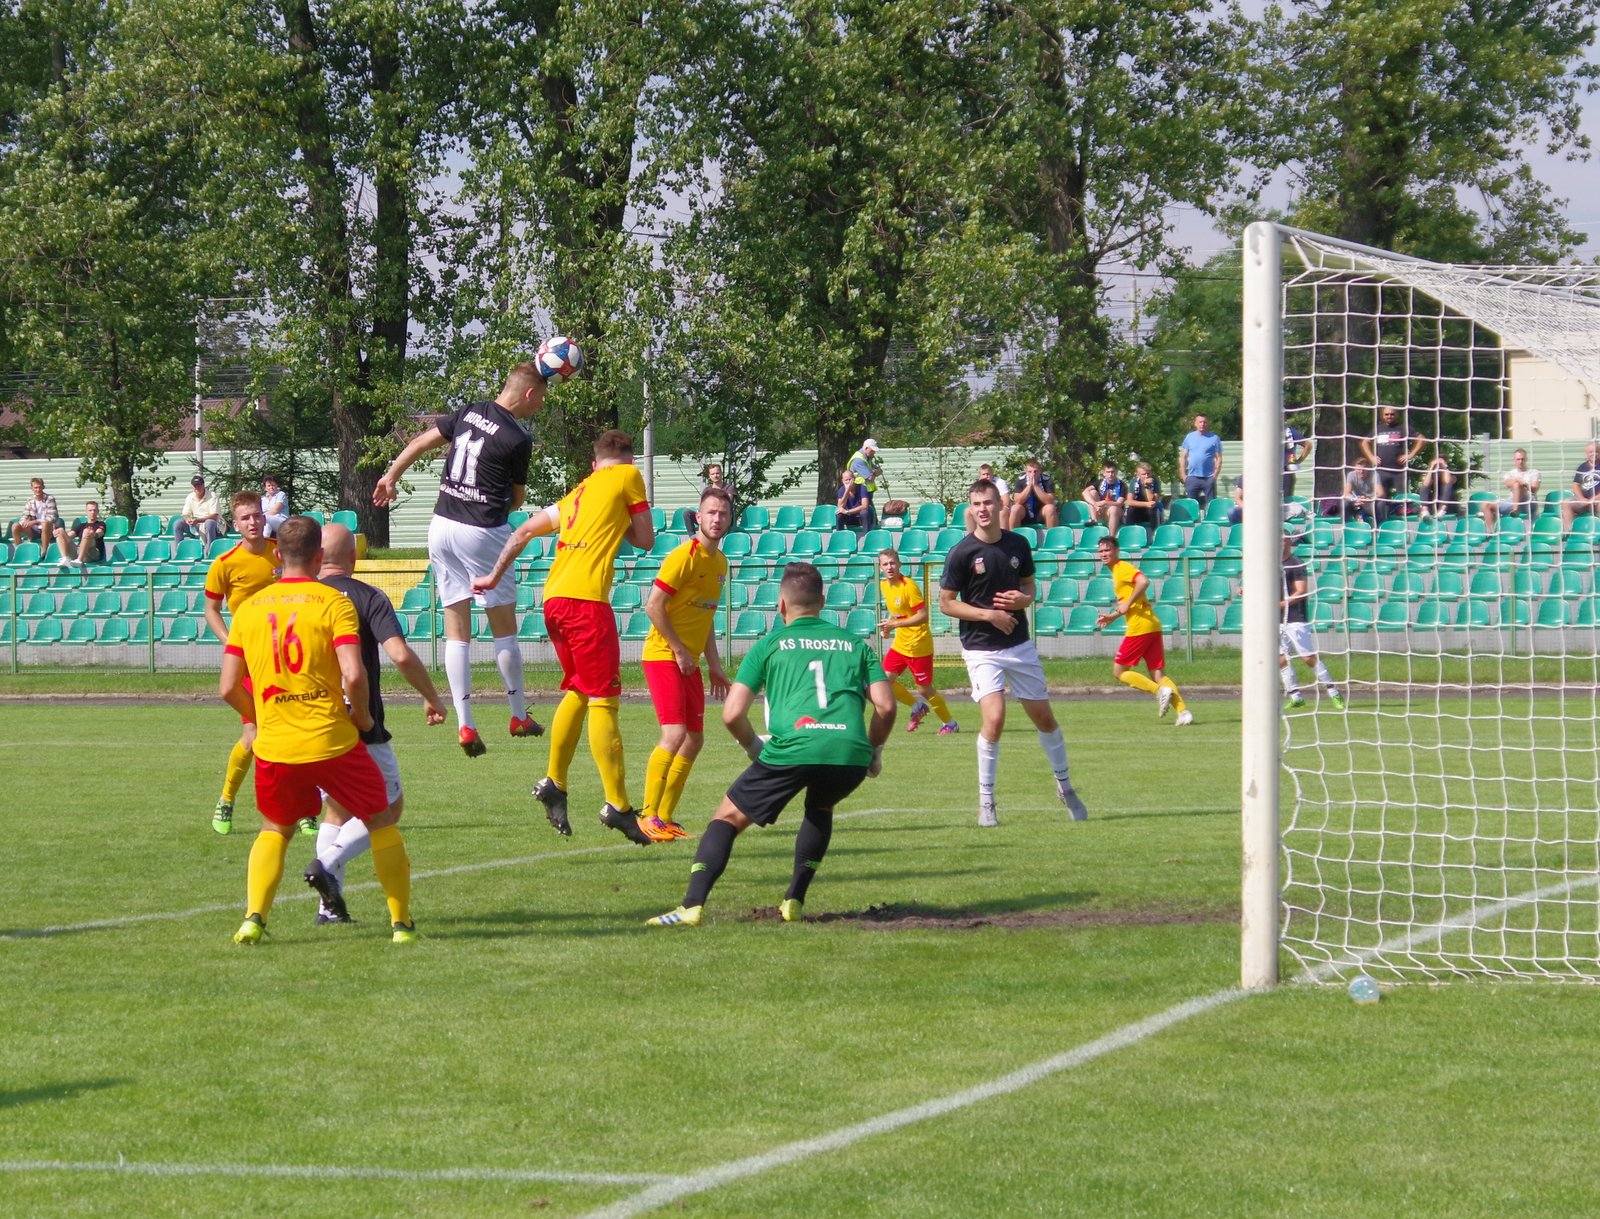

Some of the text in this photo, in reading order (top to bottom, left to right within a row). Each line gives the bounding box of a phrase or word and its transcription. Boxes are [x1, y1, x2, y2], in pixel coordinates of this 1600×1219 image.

[463, 411, 499, 436] HURAGAN
[450, 429, 485, 487] 11
[268, 611, 303, 675] 16
[779, 638, 852, 652] KS TROSZYN
[275, 689, 329, 705] MATBUD
[808, 660, 828, 710] 1
[805, 722, 847, 730] MATBUD
